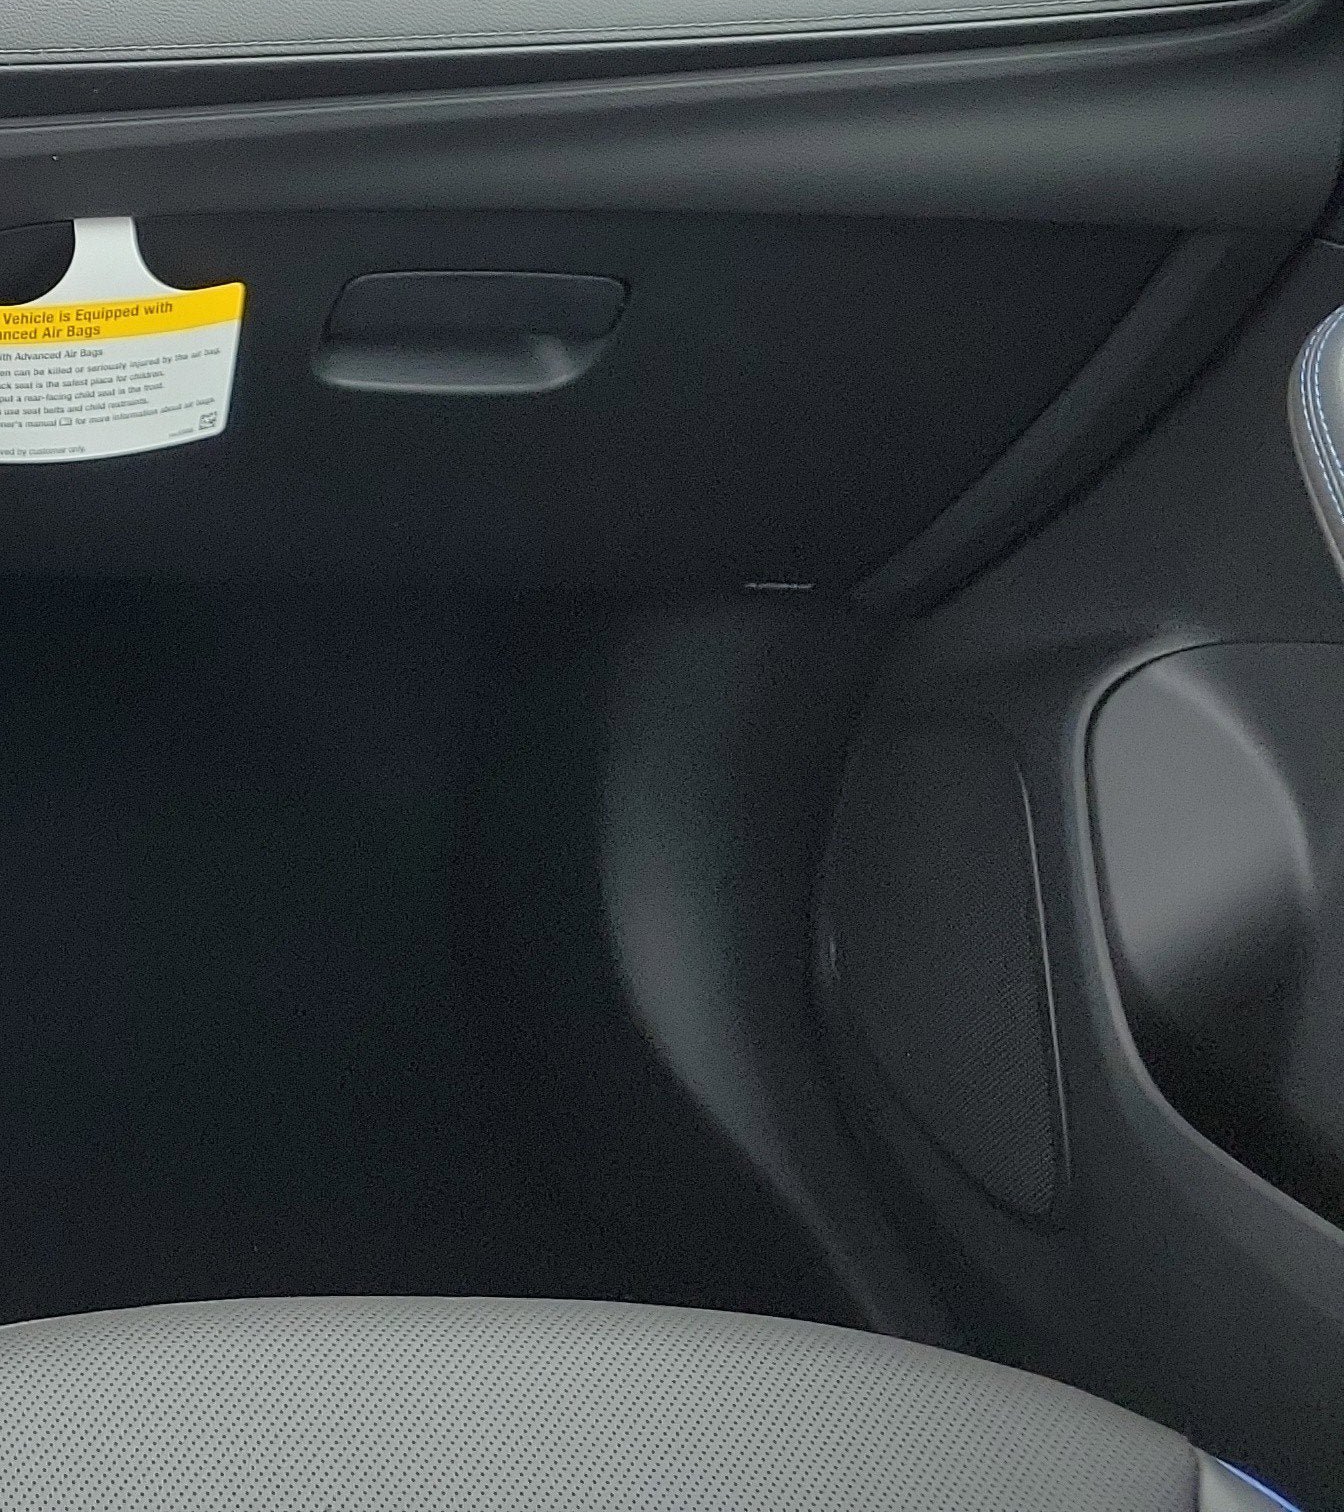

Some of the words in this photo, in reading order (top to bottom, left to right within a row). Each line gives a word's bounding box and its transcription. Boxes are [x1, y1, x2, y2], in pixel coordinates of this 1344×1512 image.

[2, 312, 54, 325] Vehicle
[59, 310, 71, 322] is
[75, 304, 139, 322] Equipped
[143, 301, 174, 316] with
[42, 327, 63, 339] Air
[66, 325, 101, 338] Bags
[14, 351, 62, 361] Advanced
[64, 349, 78, 358] Air
[80, 348, 103, 359] Bags
[14, 369, 31, 377] can
[33, 368, 45, 376] be
[47, 366, 72, 375] killed
[162, 356, 172, 365] by
[15, 381, 33, 389] seat
[46, 380, 60, 388] the
[116, 375, 128, 383] for
[0, 394, 14, 404] put
[24, 392, 72, 402] rear-facing
[22, 407, 41, 416] seat
[67, 405, 83, 413] and
[75, 417, 86, 425] for
